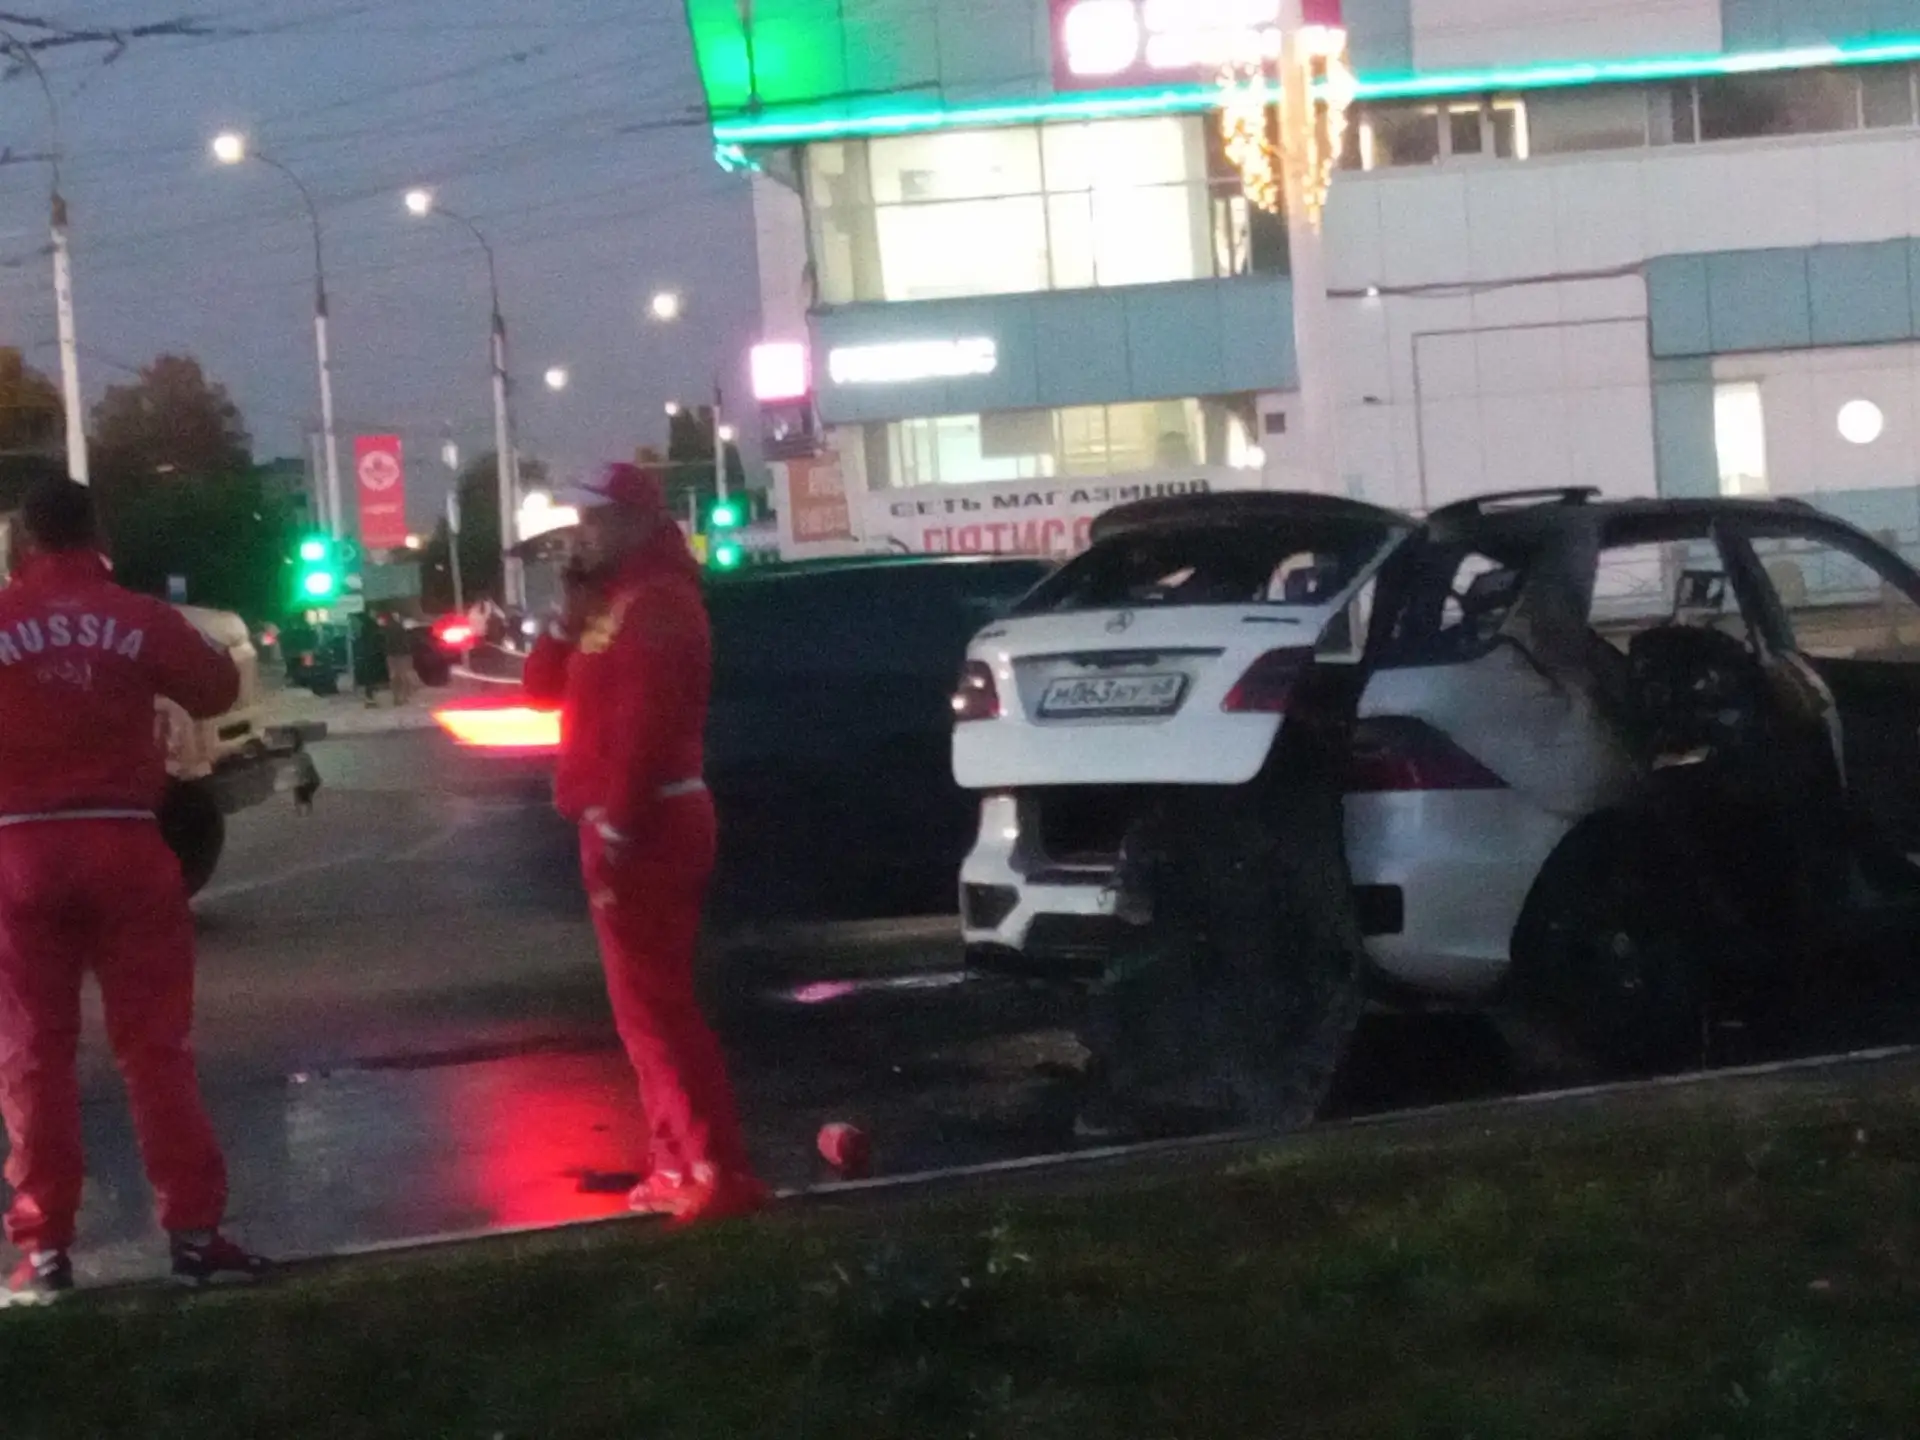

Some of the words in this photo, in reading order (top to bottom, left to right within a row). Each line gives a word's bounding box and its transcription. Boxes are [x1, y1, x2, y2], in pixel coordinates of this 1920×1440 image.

[890, 498, 981, 517] СЕТЬ
[992, 478, 1211, 510] МАГАЗИНОВ
[0, 613, 143, 666] RUSSIA
